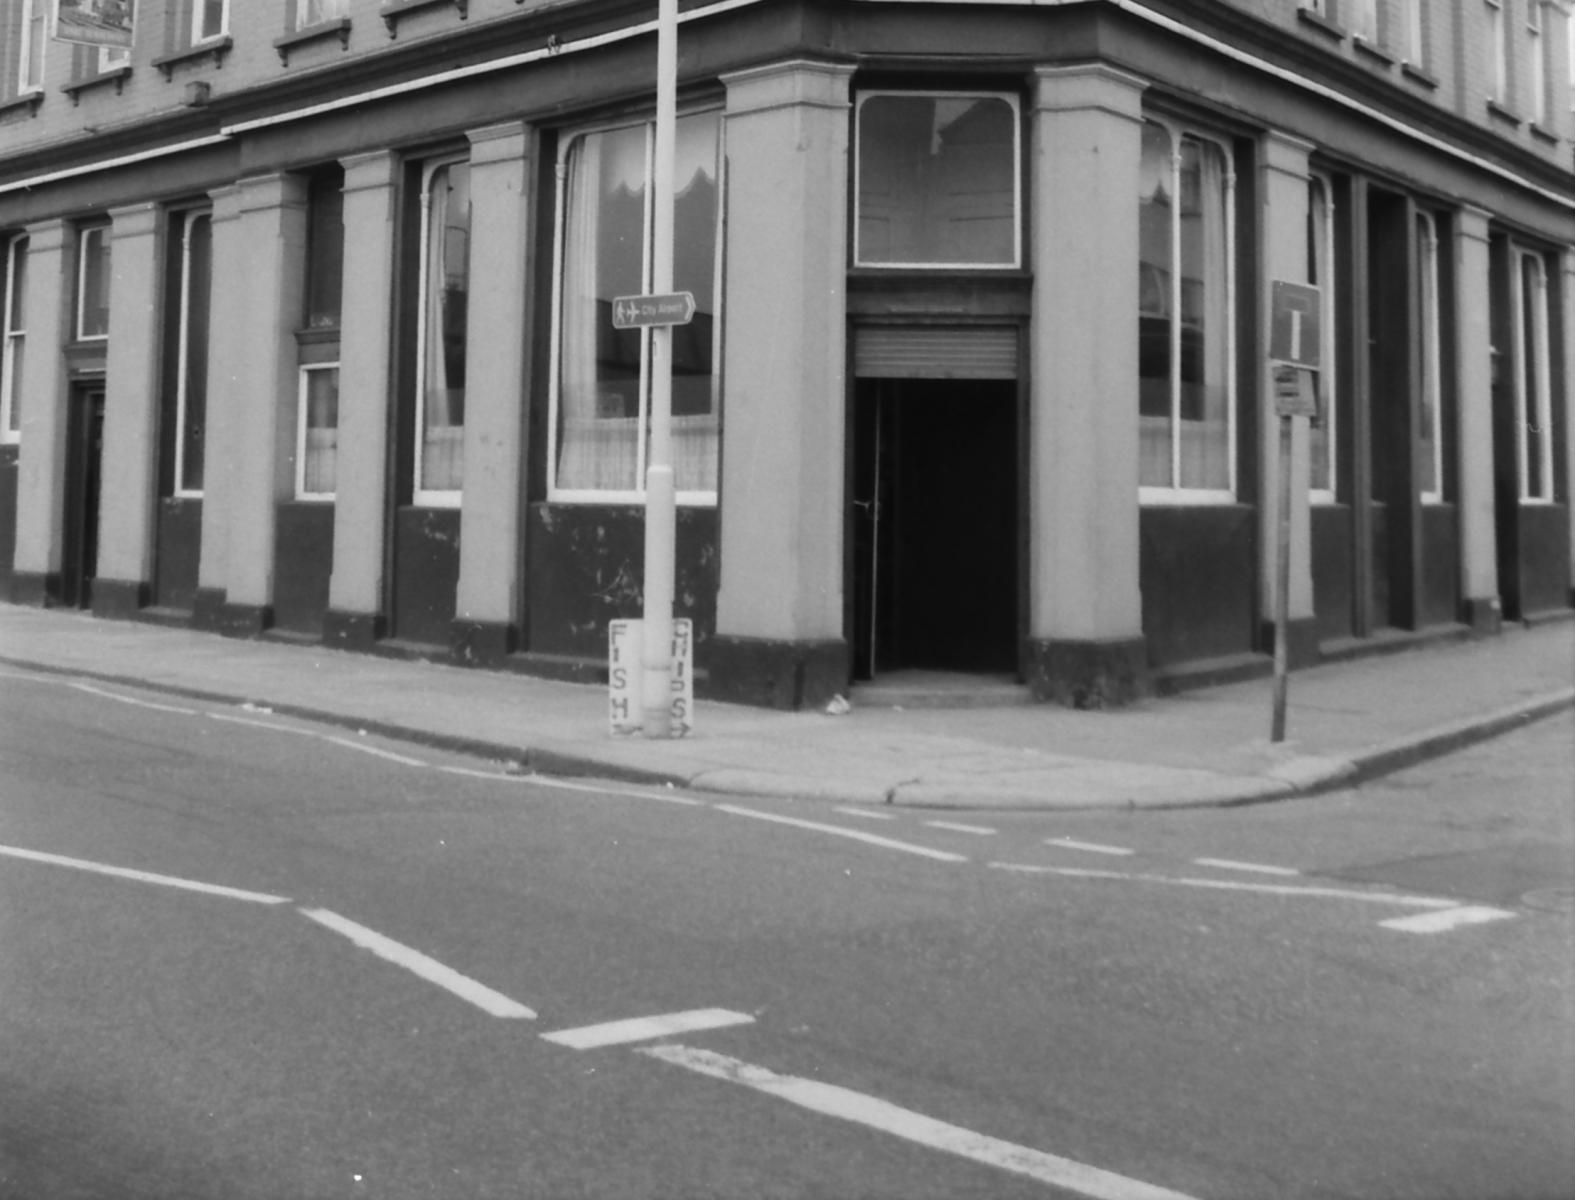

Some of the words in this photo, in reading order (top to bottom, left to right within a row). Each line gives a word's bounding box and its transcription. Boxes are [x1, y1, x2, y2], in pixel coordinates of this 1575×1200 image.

[641, 305, 656, 316] City
[658, 303, 683, 314] Airport
[611, 623, 628, 718] FISH
